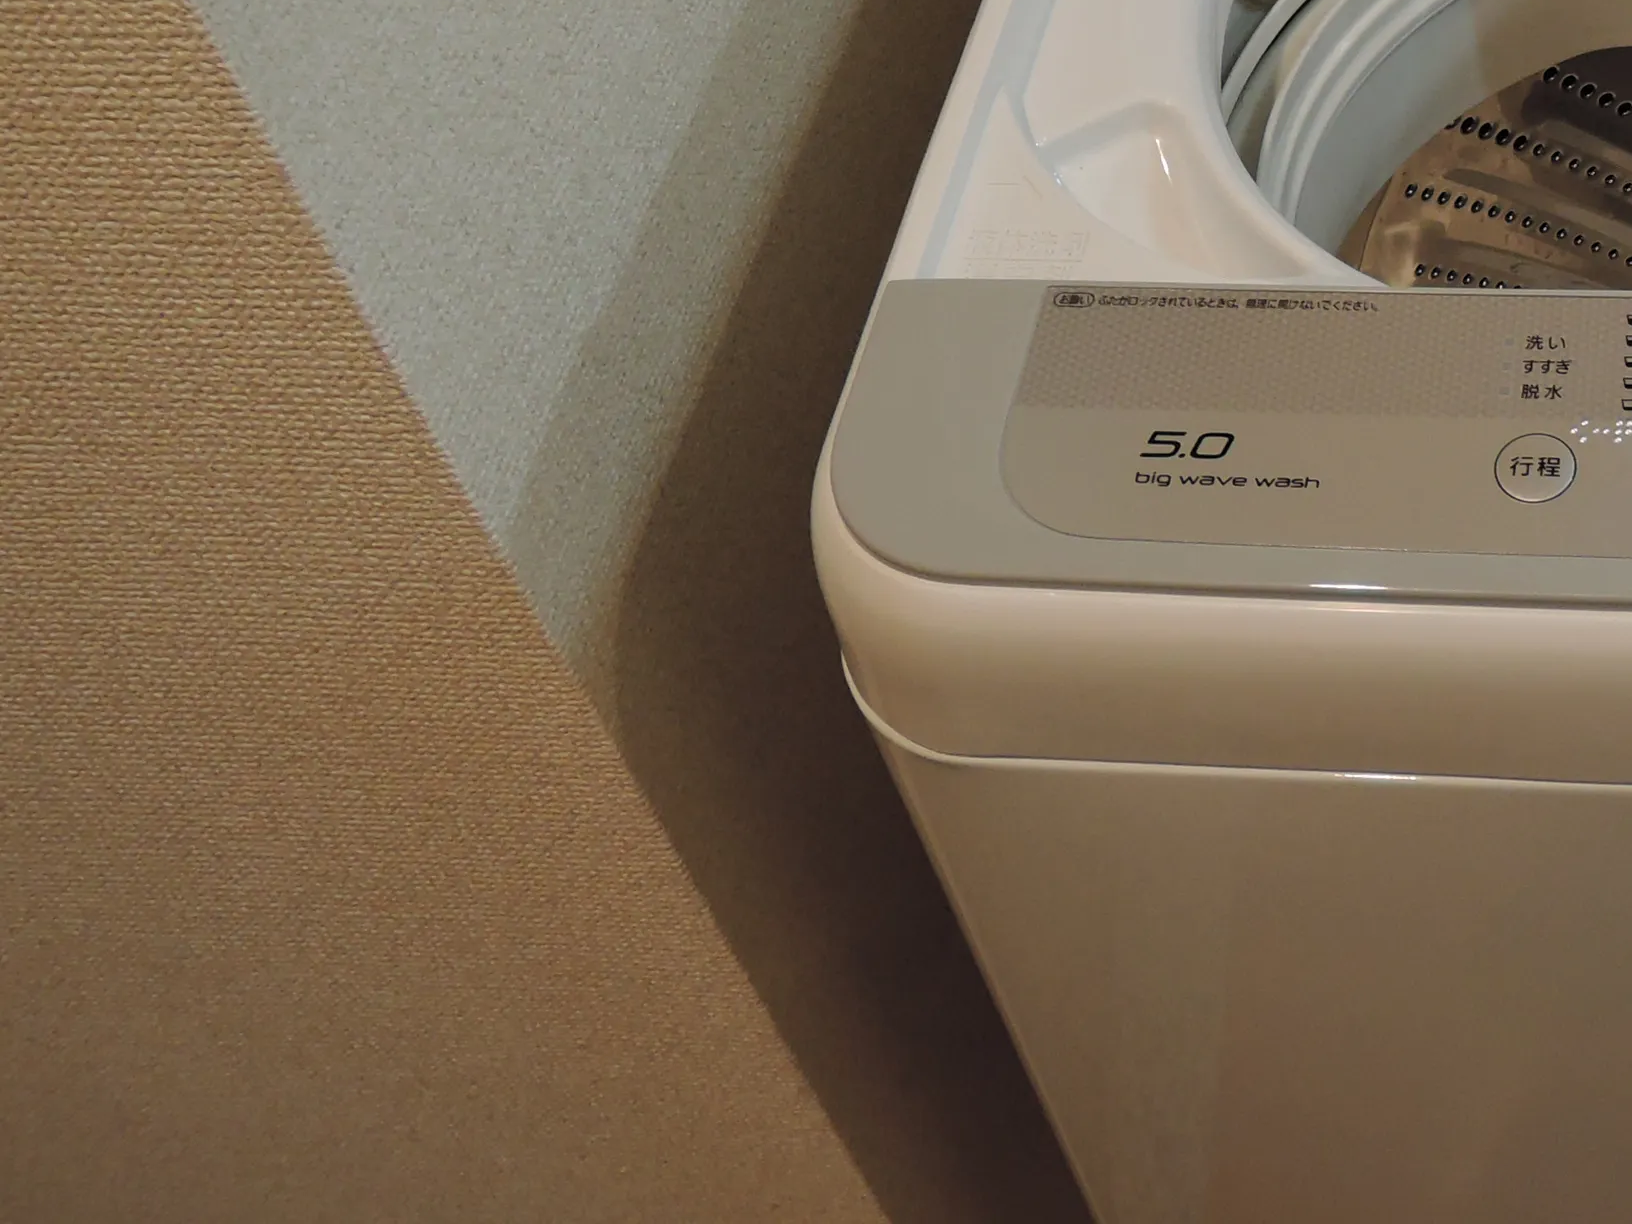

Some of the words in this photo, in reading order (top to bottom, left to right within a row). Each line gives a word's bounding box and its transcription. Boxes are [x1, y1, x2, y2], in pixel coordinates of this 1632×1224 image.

[1525, 335, 1566, 351] 洗い
[1522, 359, 1572, 375] すすぎ
[1520, 384, 1563, 400] 脱水
[1139, 430, 1236, 460] 5.0
[1509, 456, 1561, 478] 行程
[1134, 471, 1172, 487] big
[1179, 474, 1248, 487] wave
[1255, 476, 1320, 489] wash
